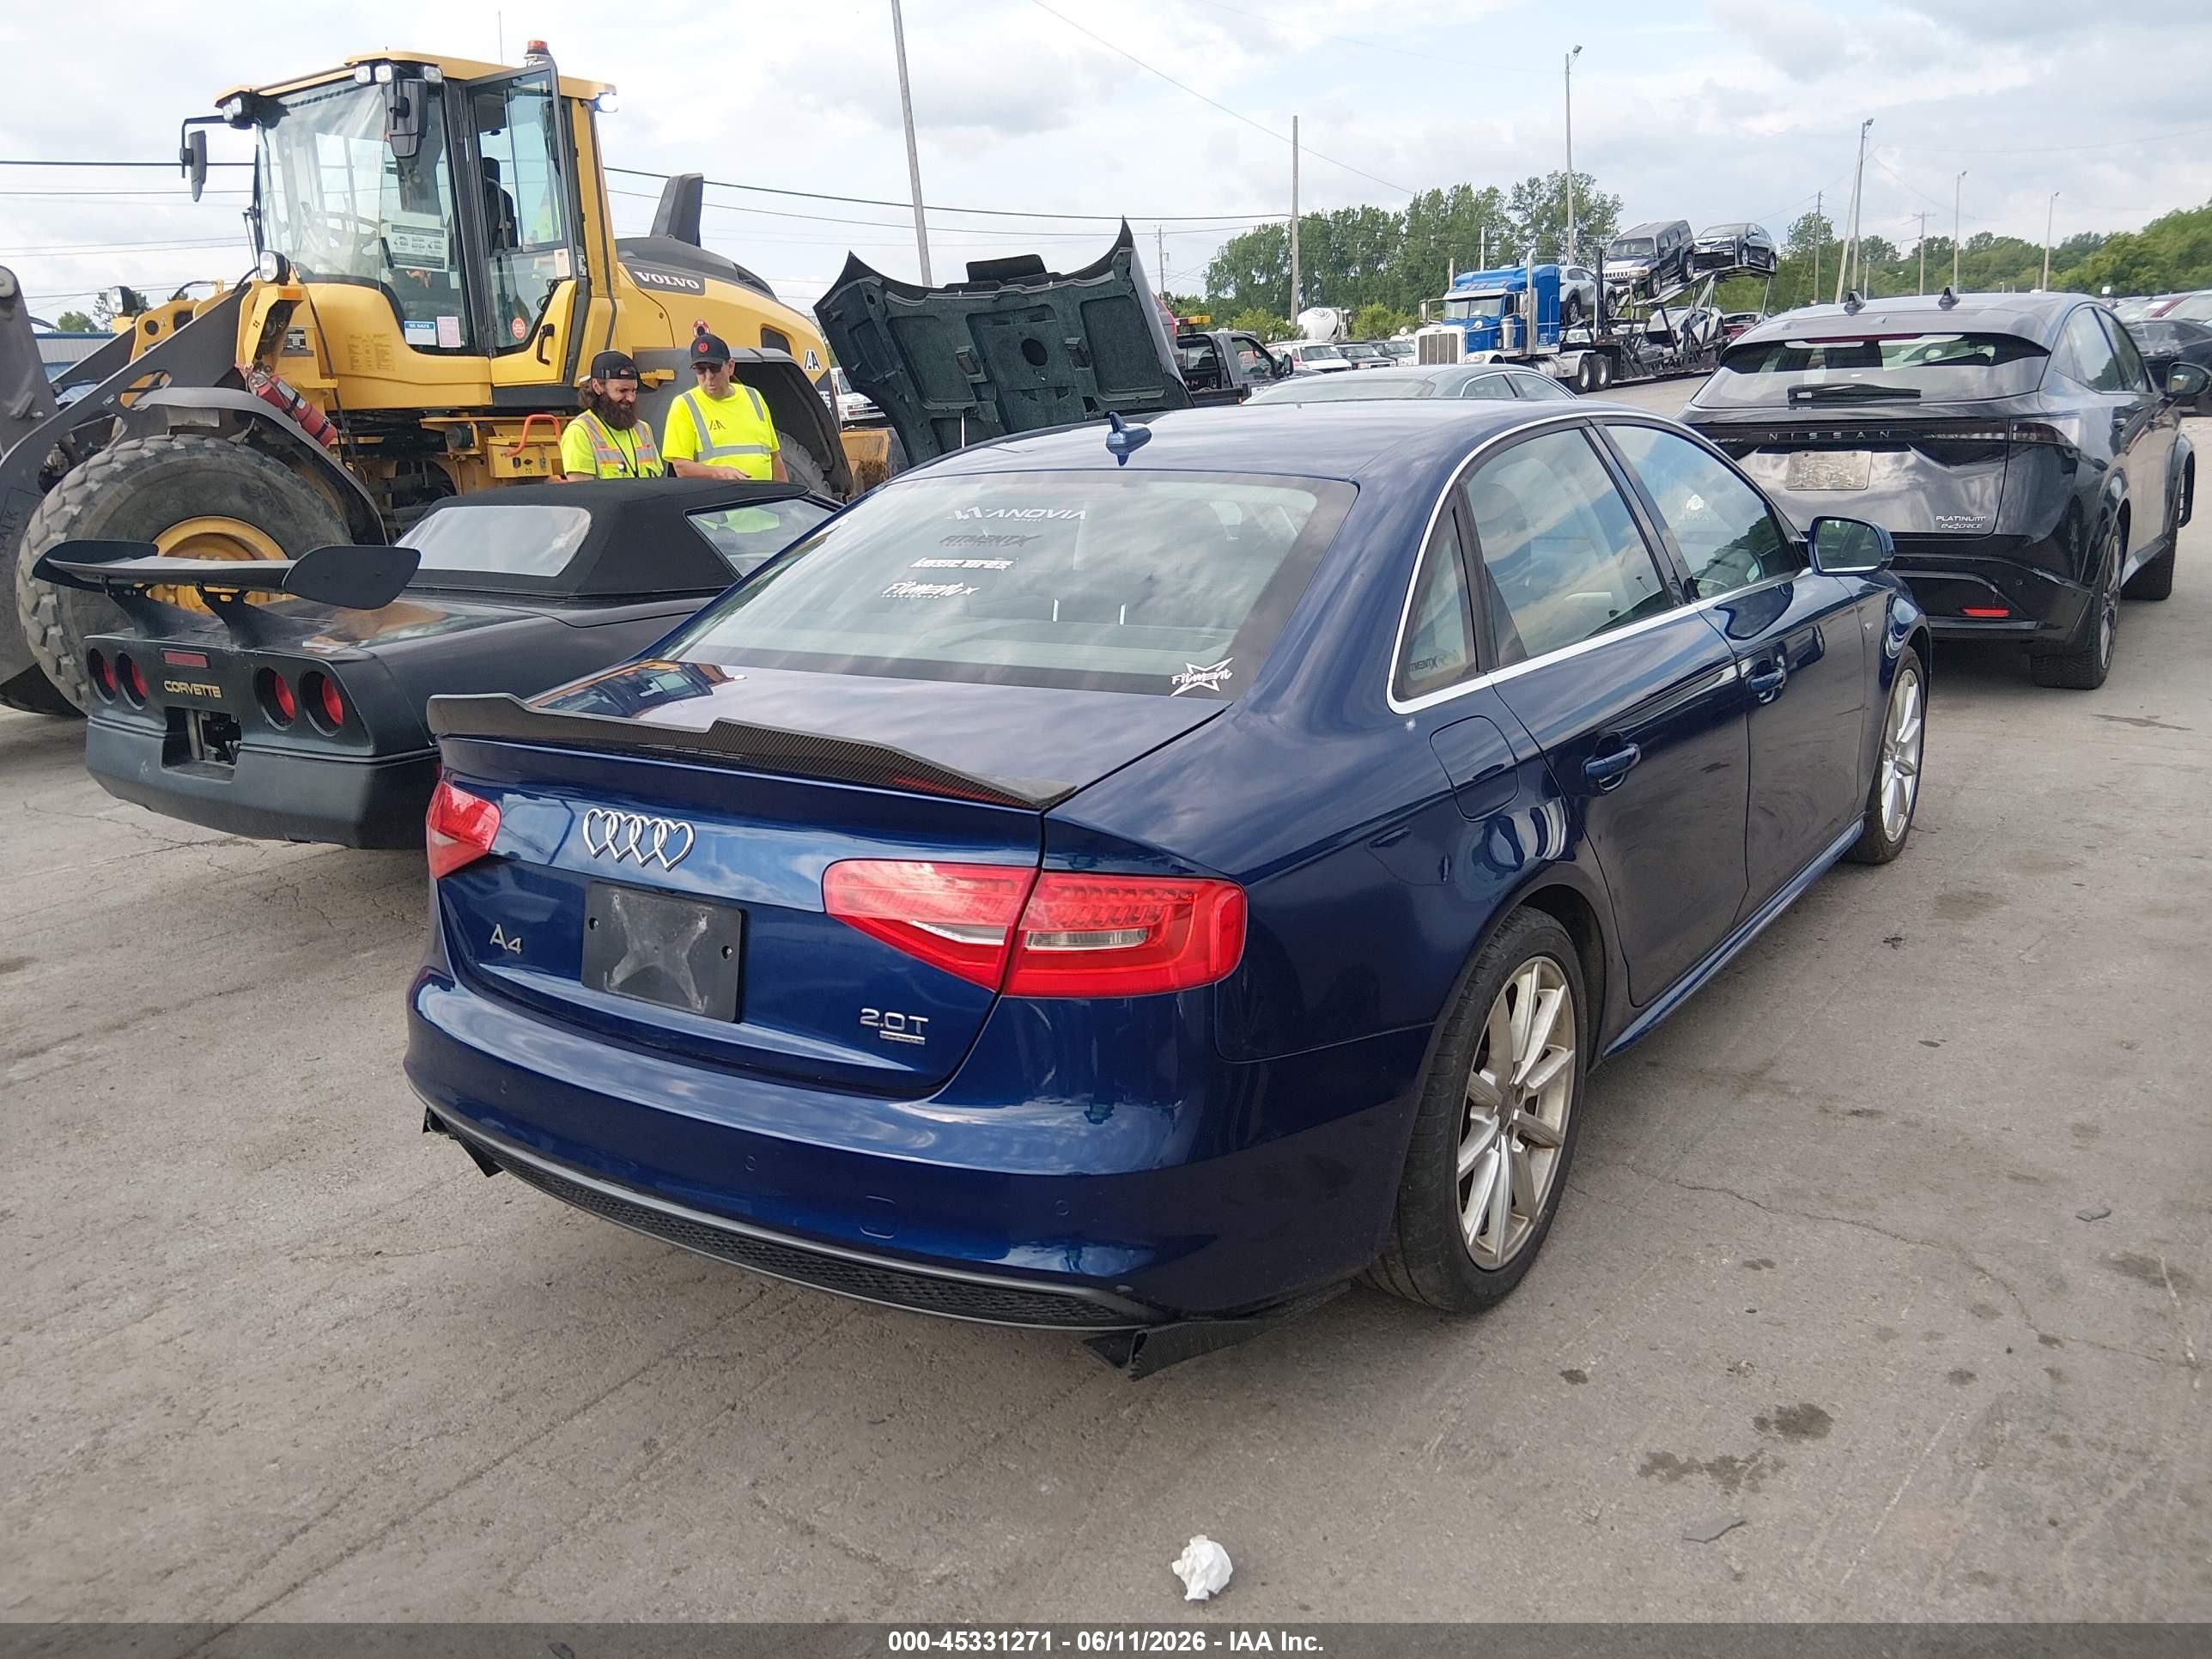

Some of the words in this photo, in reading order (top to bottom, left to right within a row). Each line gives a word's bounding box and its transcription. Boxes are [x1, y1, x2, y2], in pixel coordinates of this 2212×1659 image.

[634, 270, 700, 289] VOLVO
[1769, 431, 1890, 441] NISSAN
[1170, 669, 1233, 685] Fitment
[164, 680, 222, 698] CORVETTE
[489, 923, 522, 955] A4
[860, 1007, 929, 1035] 2.0T
